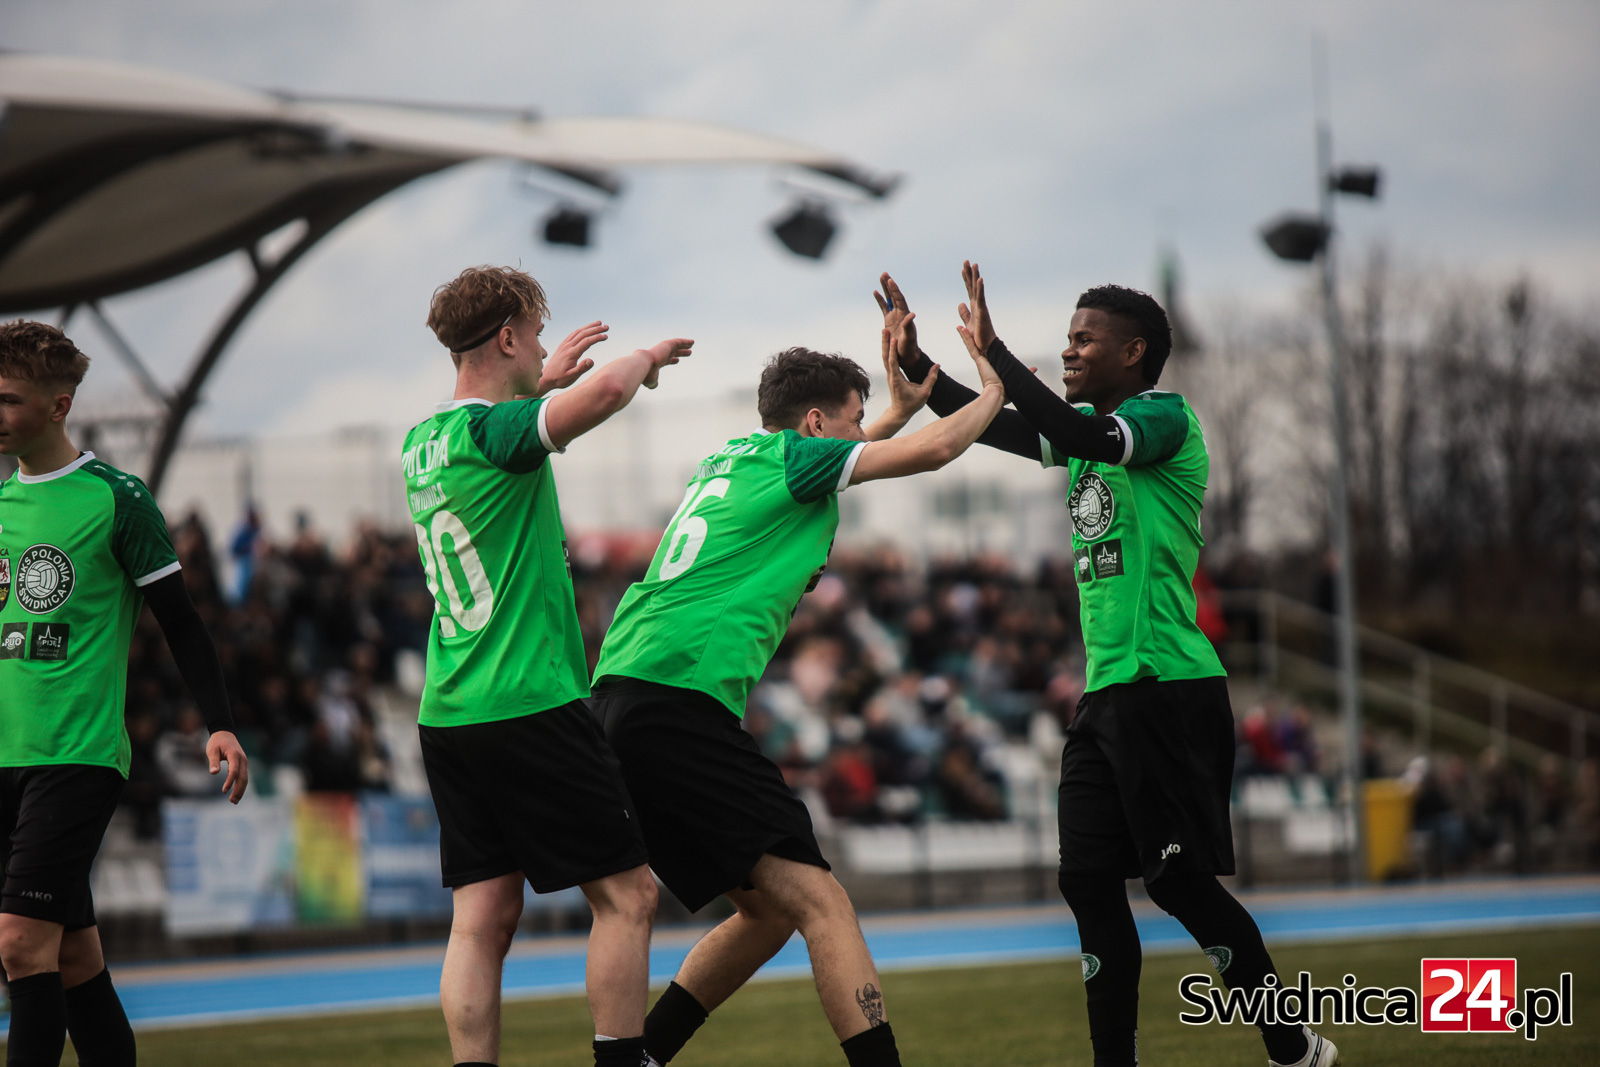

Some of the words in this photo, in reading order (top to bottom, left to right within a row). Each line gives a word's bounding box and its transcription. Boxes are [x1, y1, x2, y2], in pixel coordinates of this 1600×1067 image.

[1070, 491, 1079, 517] MKS
[1076, 477, 1109, 503] POLONIA
[19, 556, 32, 582] MKS
[31, 549, 70, 583] POLONIA
[20, 890, 53, 902] JAKO
